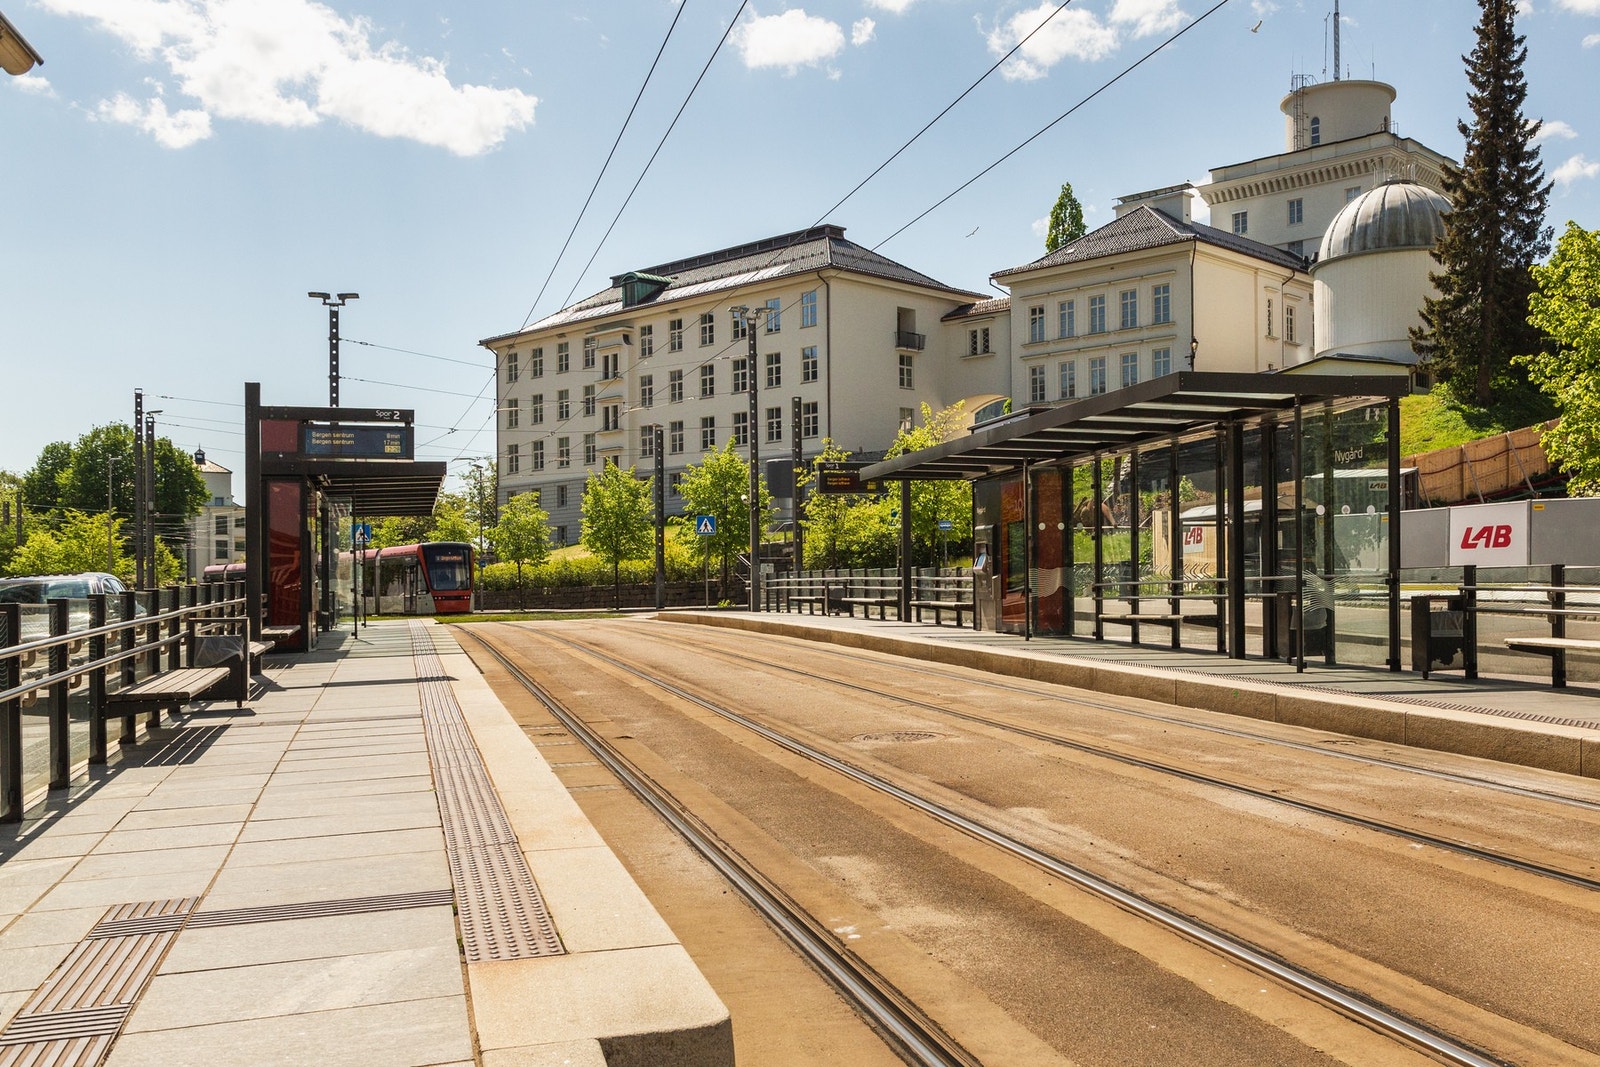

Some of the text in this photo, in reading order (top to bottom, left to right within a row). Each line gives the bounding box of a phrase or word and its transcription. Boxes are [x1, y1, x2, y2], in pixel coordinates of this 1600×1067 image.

[375, 410, 400, 420] Spor 2
[312, 431, 331, 439] Bergen
[1334, 446, 1363, 464] Nygård
[1184, 527, 1203, 545] LAB
[1460, 525, 1513, 550] LAB
